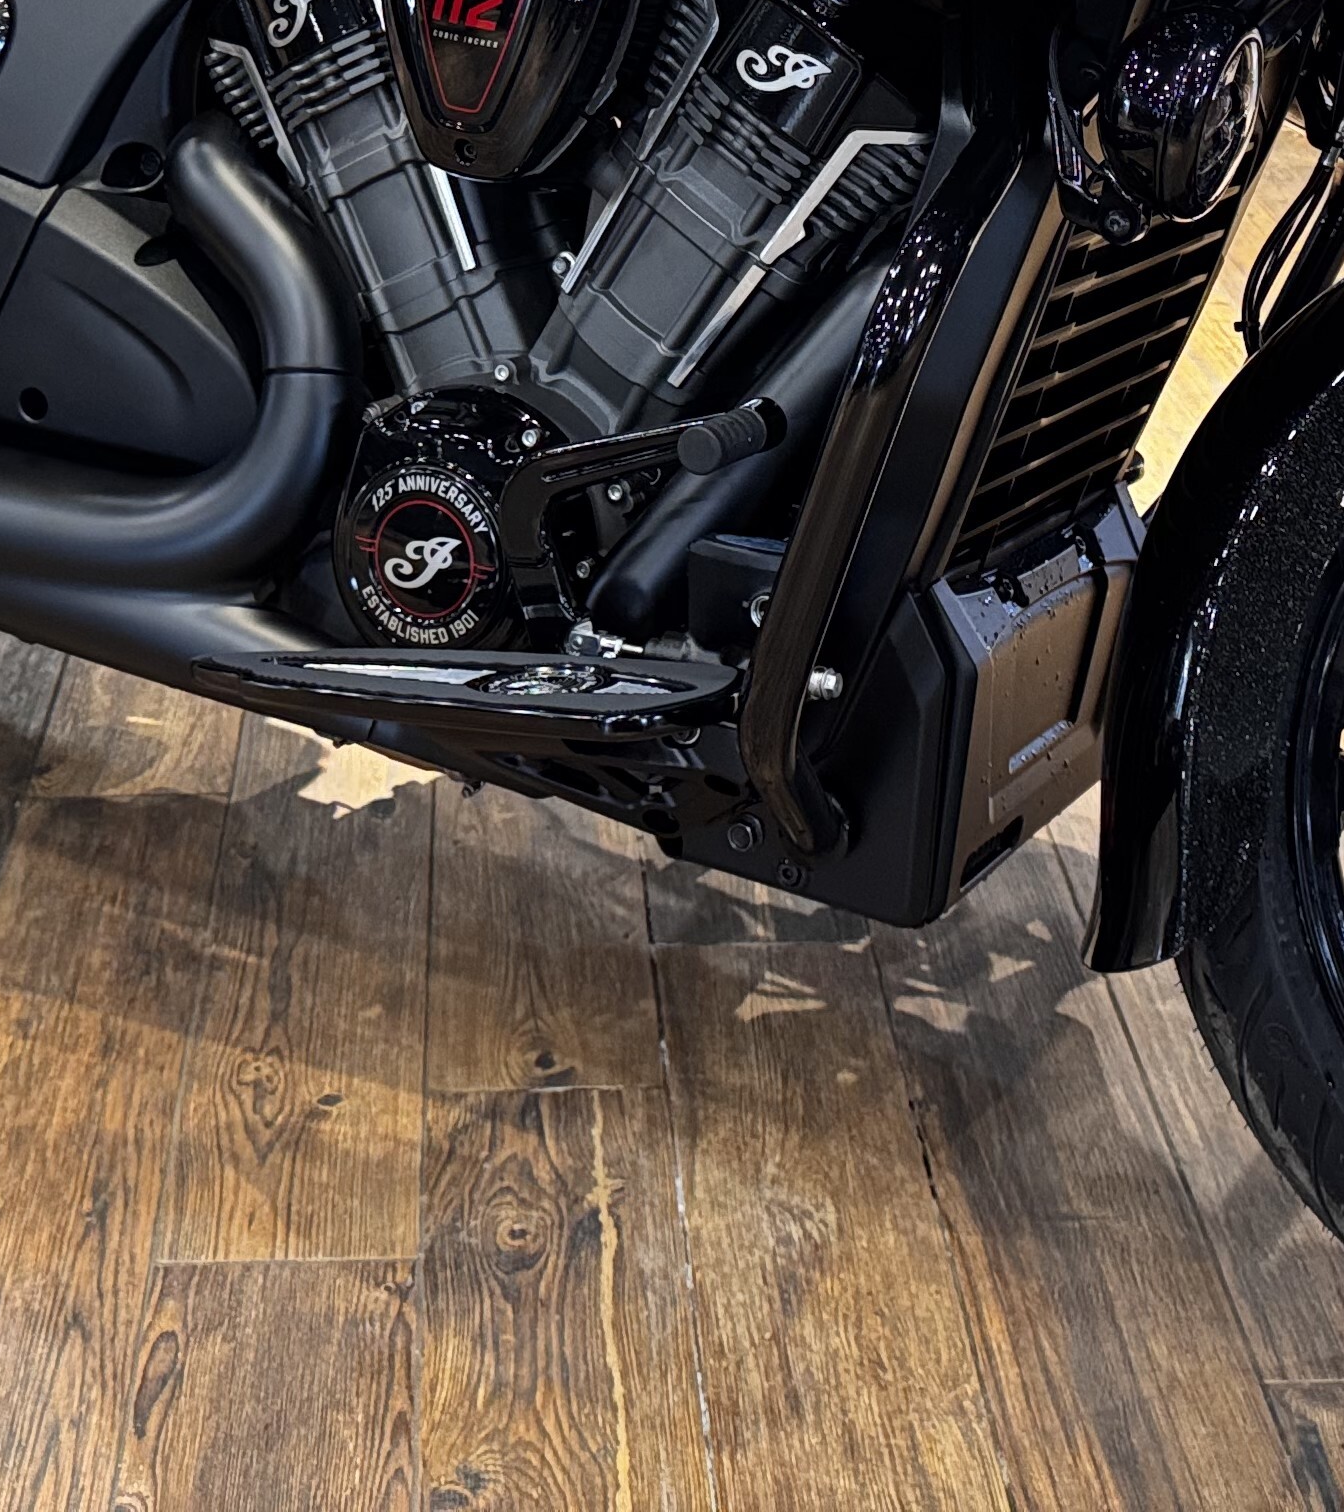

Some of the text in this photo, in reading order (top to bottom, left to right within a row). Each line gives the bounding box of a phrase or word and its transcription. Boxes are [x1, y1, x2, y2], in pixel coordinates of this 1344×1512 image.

[433, 29, 499, 49] CUBIC INCHES
[371, 474, 489, 534] 125 ANNIVERSARY
[362, 584, 480, 645] ESTABLISHED 1901
